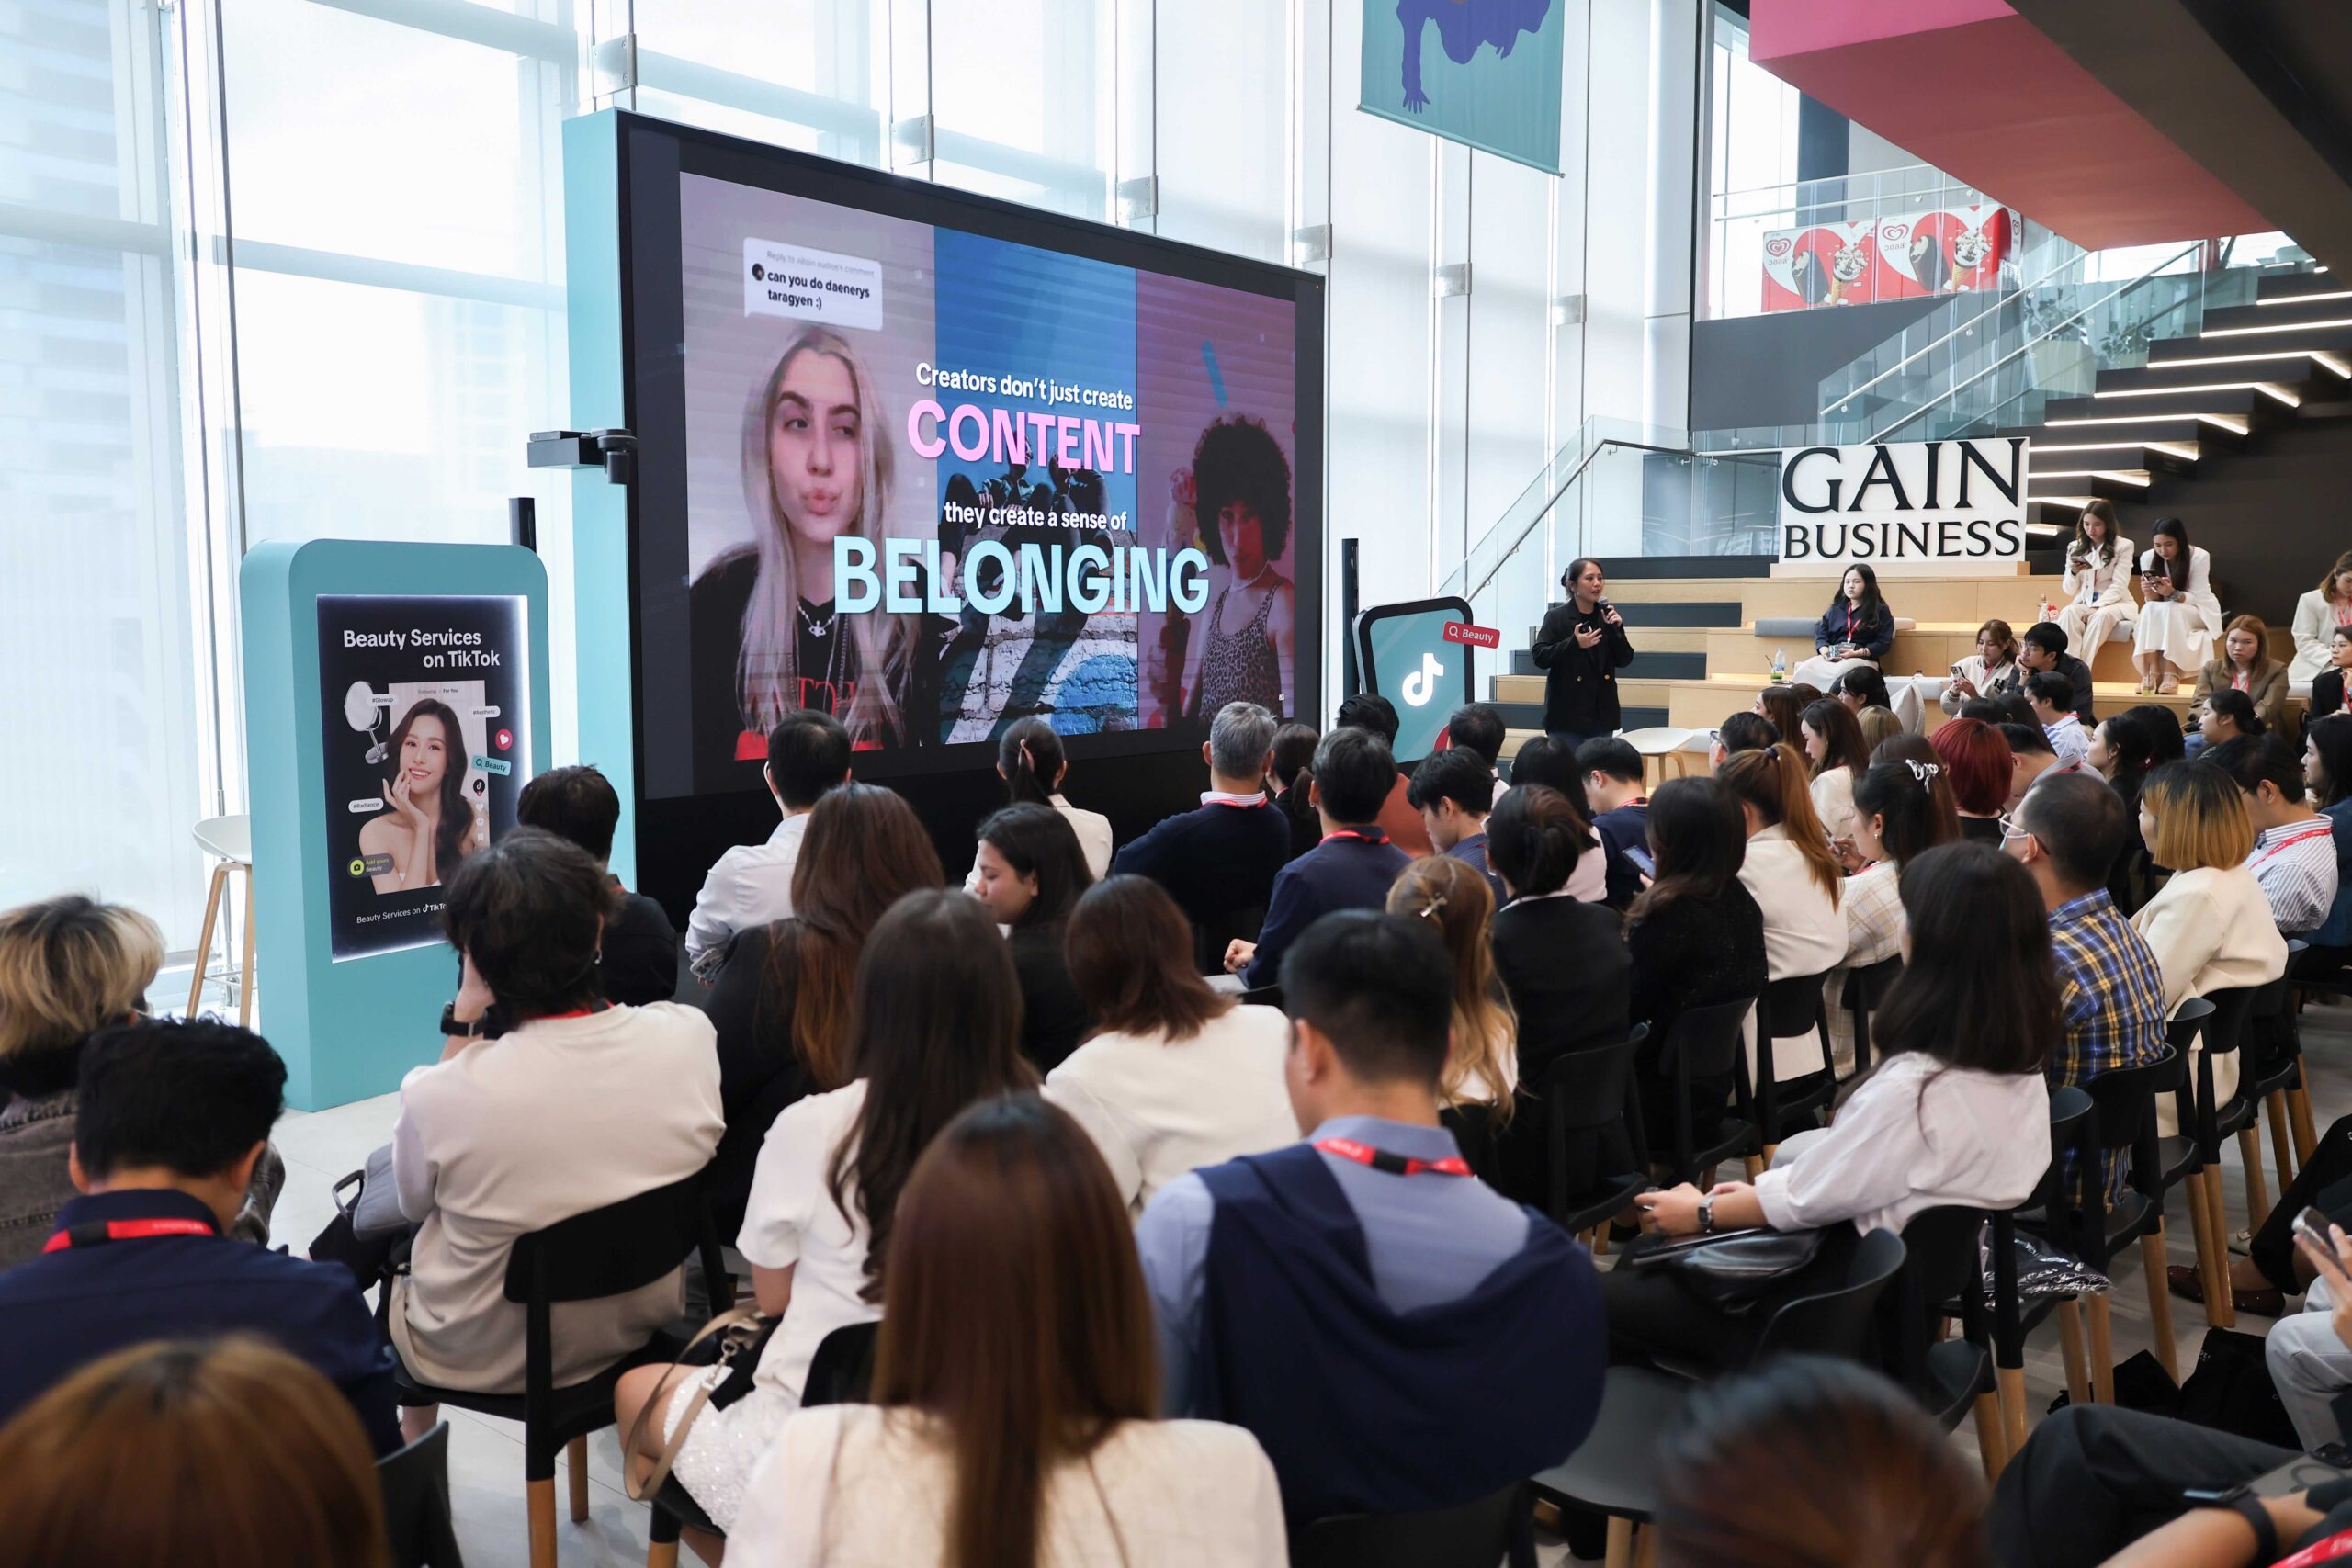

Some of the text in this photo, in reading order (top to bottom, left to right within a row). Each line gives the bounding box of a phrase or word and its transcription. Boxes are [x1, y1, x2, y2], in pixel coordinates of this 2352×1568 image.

[767, 272, 870, 299] can you do daenerys
[768, 289, 822, 310] taragyen :)
[916, 362, 997, 394] Creators
[1048, 380, 1080, 405] just
[1082, 389, 1133, 411] create
[908, 399, 1141, 474] CONTENT
[1782, 438, 2026, 513] GAIN
[944, 502, 1127, 530] they create a sense of
[1783, 520, 2020, 558] BUSINESS
[833, 536, 1209, 615] BELONGING
[344, 628, 481, 650] Beauty Services
[1463, 629, 1494, 644] Beauty
[423, 650, 500, 668] on TikTok
[485, 760, 506, 772] Beauty
[356, 914, 380, 924] Beauty
[382, 909, 411, 919] Services
